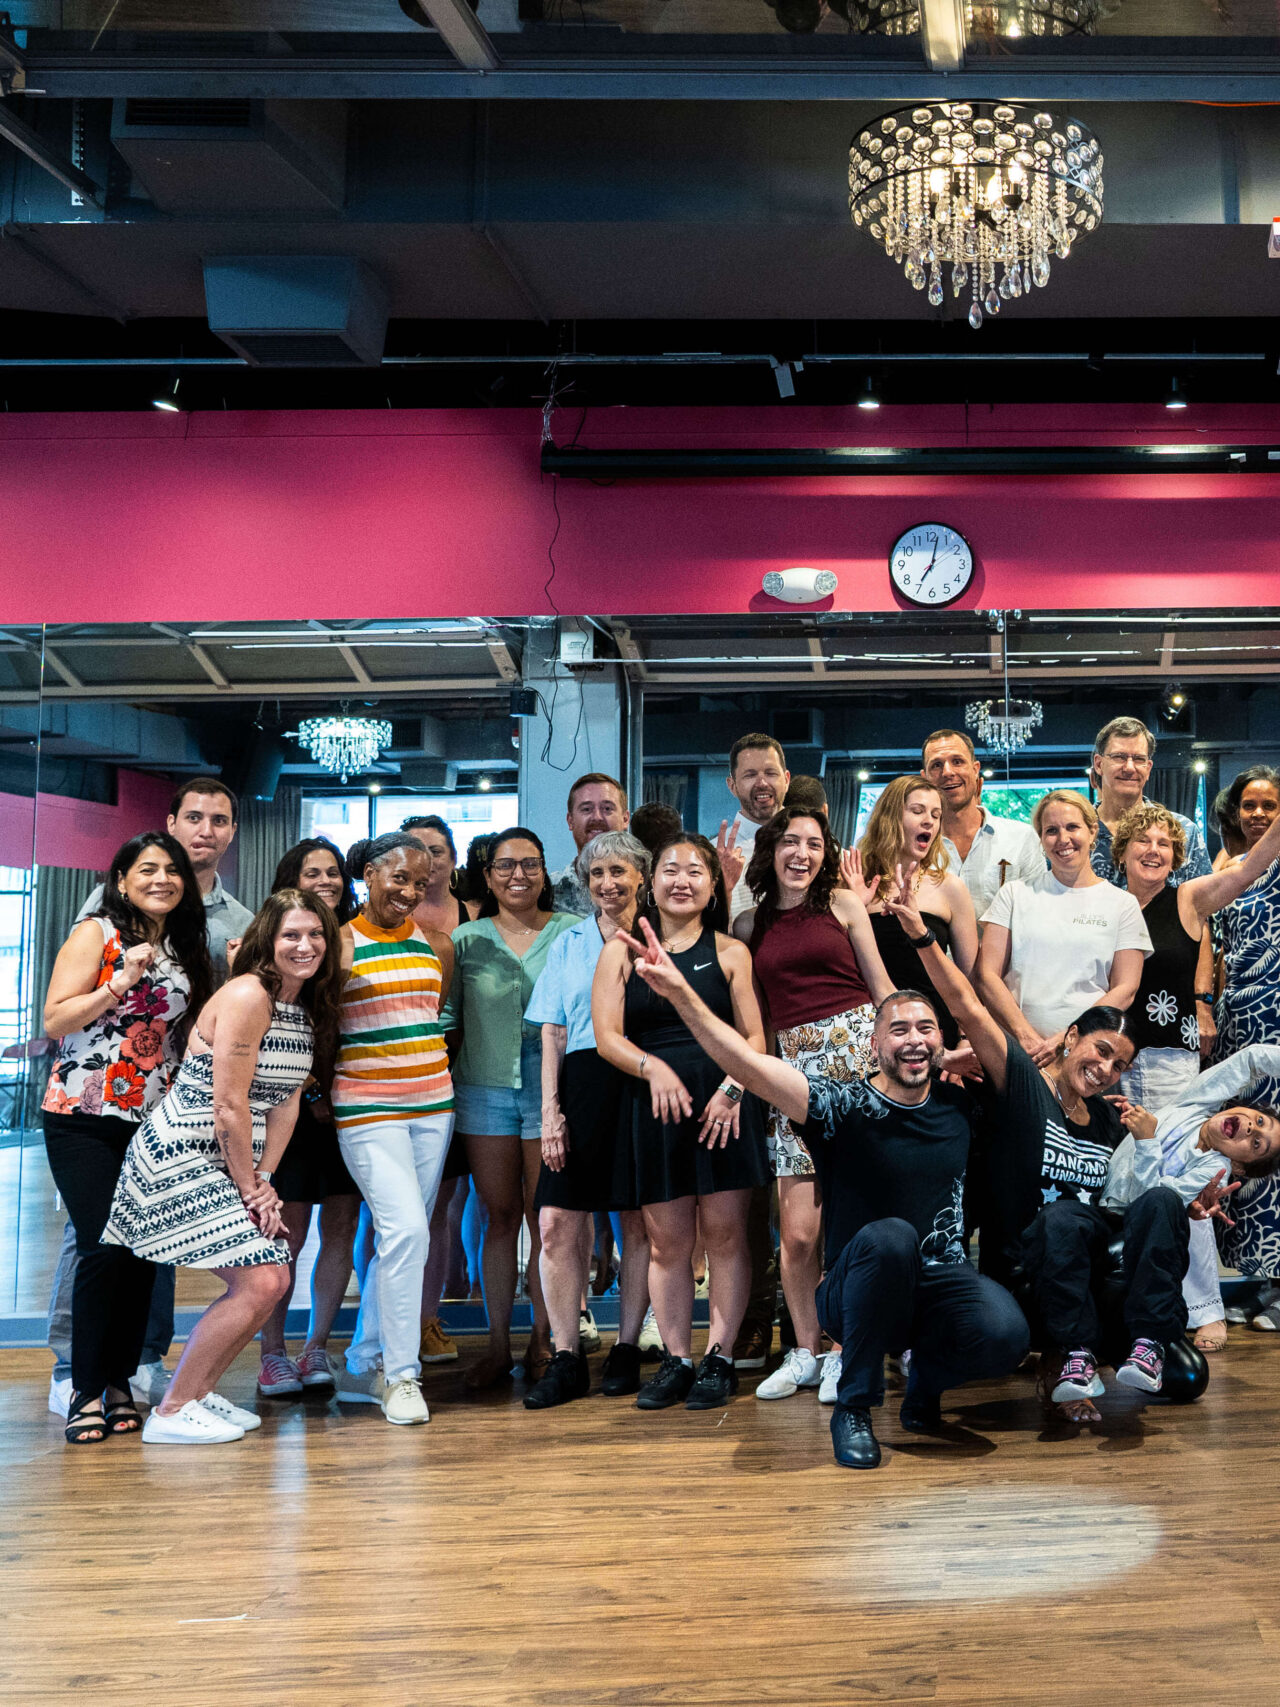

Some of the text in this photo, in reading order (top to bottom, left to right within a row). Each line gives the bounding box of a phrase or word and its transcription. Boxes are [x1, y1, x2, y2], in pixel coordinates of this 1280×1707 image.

[913, 535, 922, 546] 11
[926, 532, 937, 543] 12
[902, 546, 913, 557] 10
[953, 544, 961, 555] 2
[897, 559, 906, 570] 9
[958, 559, 966, 570] 3
[903, 574, 911, 585] 8
[953, 574, 961, 584] 4
[915, 583, 923, 595] 7
[928, 587, 936, 598] 6
[943, 583, 951, 594] 5
[1072, 918, 1108, 927] PILATES
